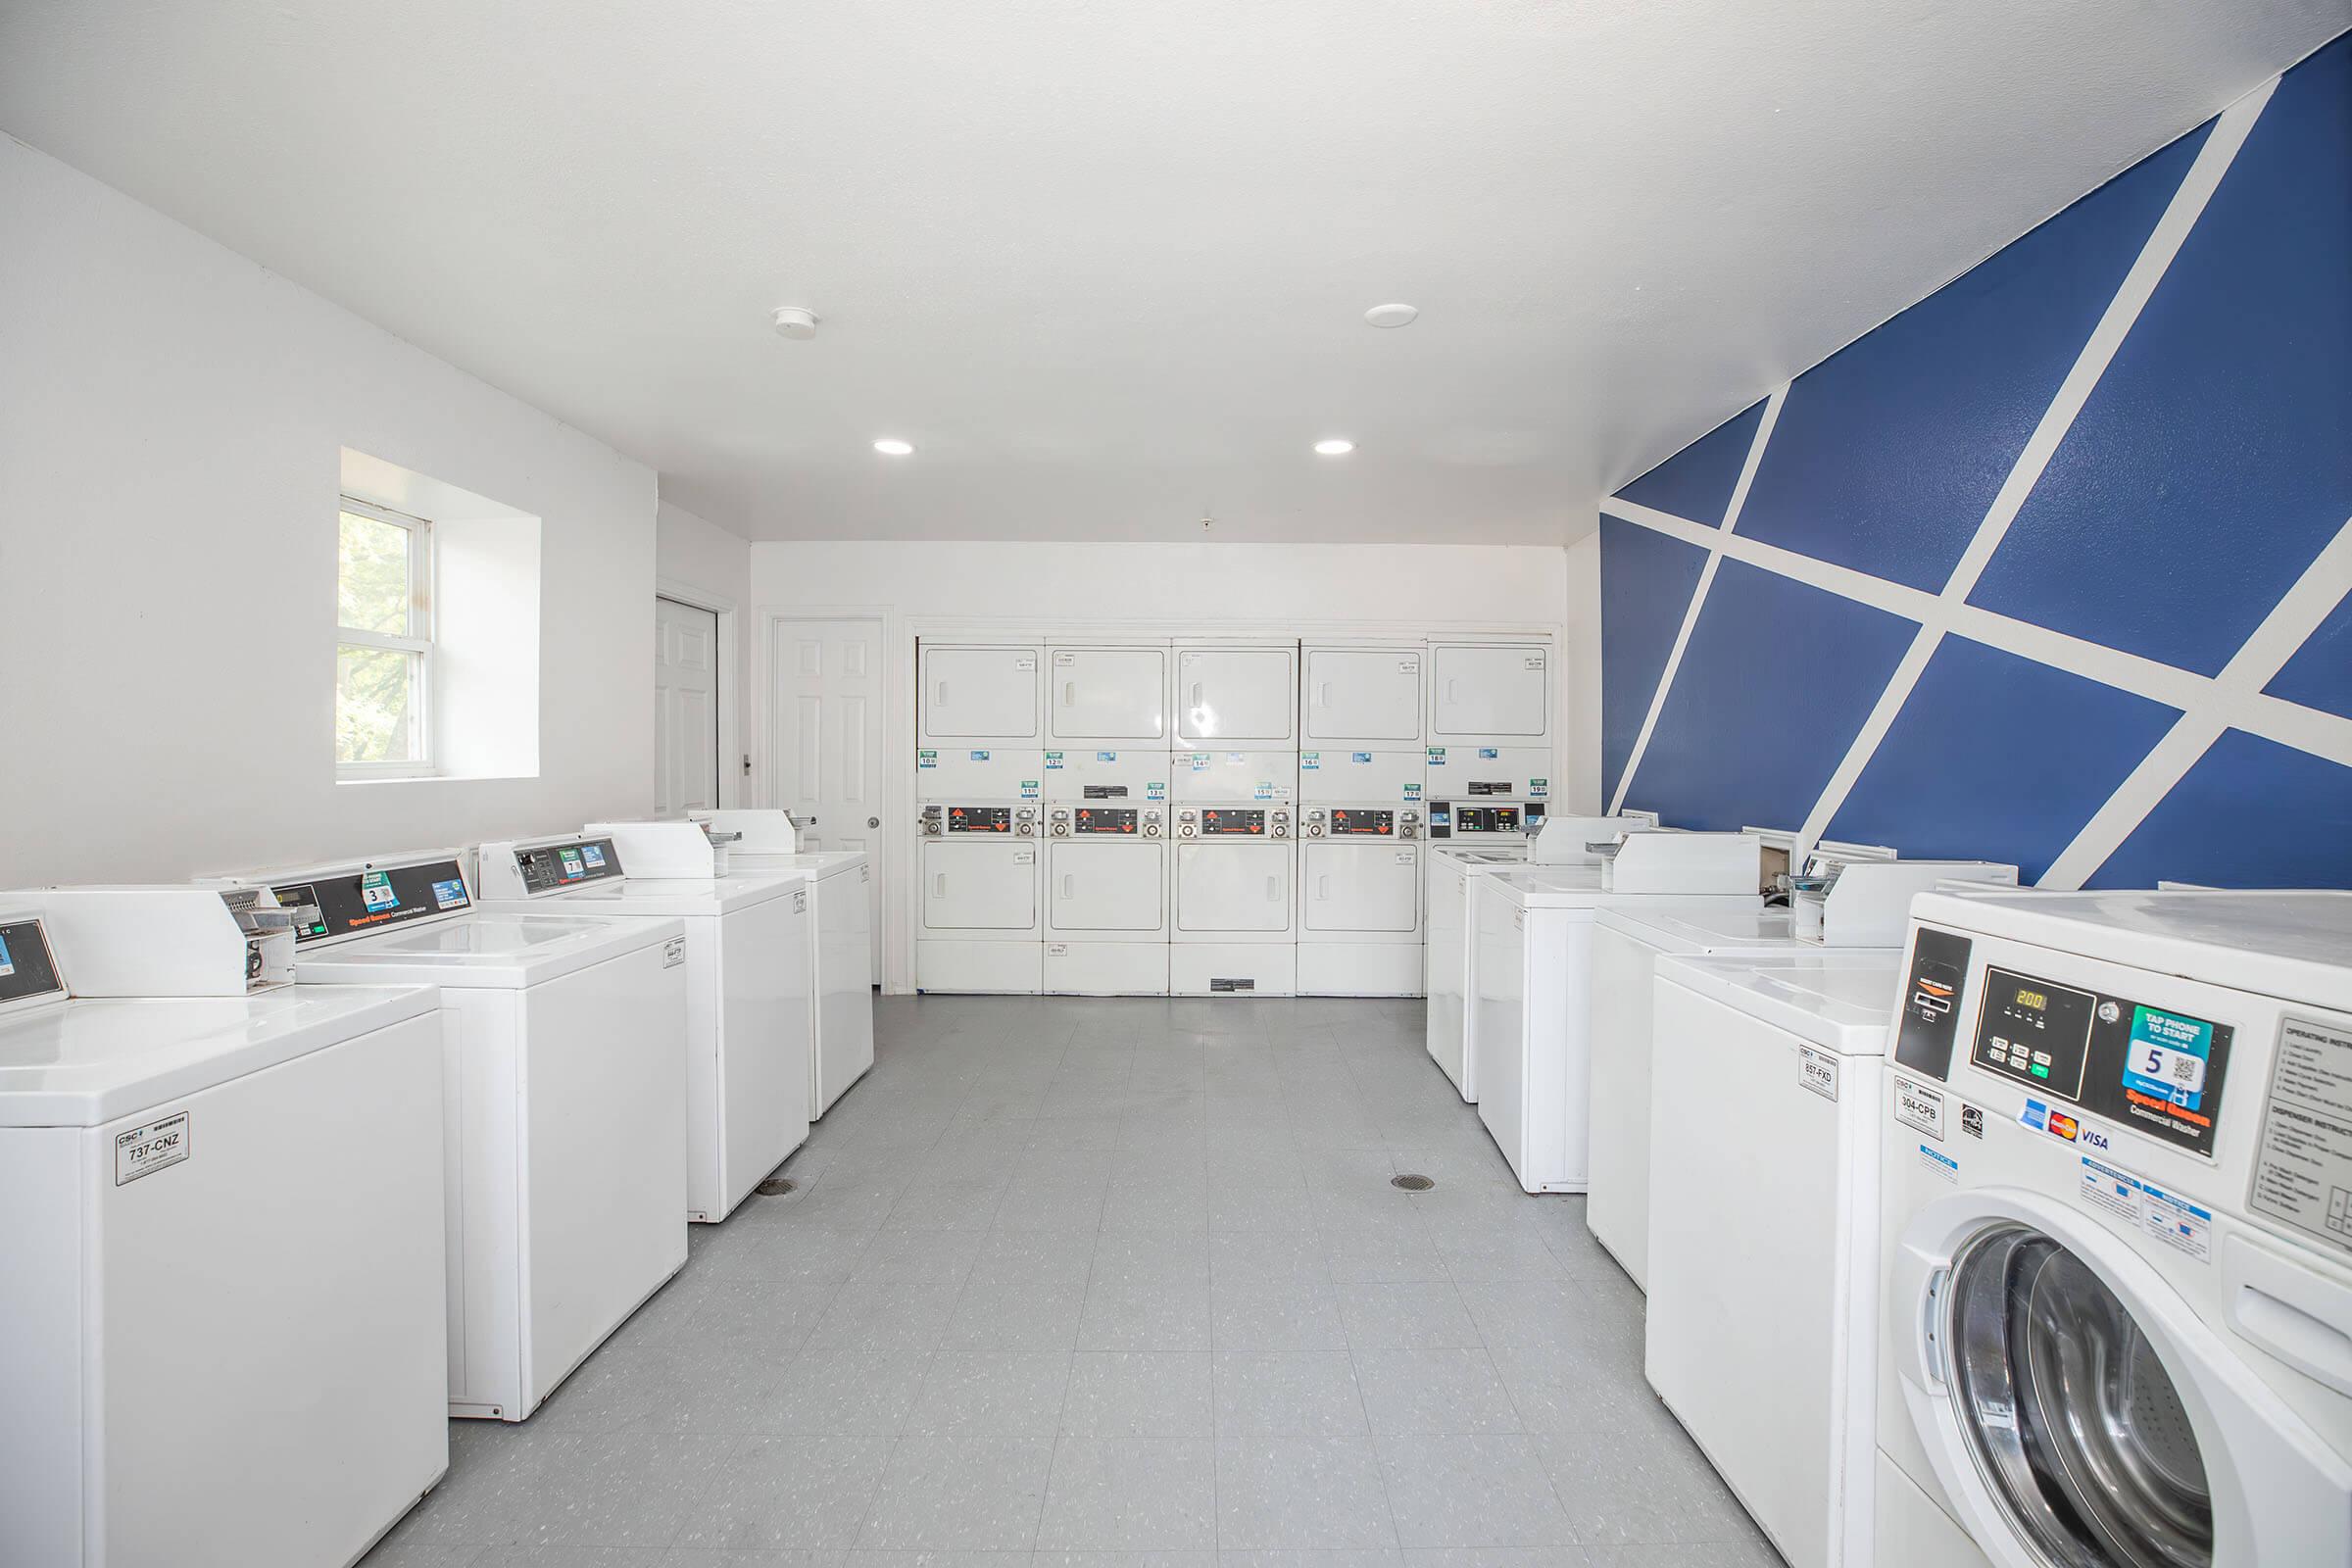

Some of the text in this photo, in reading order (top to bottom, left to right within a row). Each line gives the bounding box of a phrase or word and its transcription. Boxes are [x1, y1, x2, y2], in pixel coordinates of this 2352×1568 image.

[568, 862, 573, 871] 7
[368, 890, 377, 902] 3
[349, 915, 369, 927] Speed
[2017, 990, 2043, 1008] 200
[2145, 1013, 2201, 1036] TAP PHONE
[2147, 1022, 2196, 1043] TO START
[2285, 1027, 2328, 1044] OPERATING
[2145, 1049, 2163, 1074] 5
[1901, 1096, 1936, 1119] 304-CPB
[2126, 1088, 2167, 1111] Speed
[2130, 1104, 2201, 1138] Commercial Washer
[2272, 1105, 2314, 1125] DISPENSER
[119, 1132, 138, 1145] CSC
[128, 1133, 179, 1161] 737-CNZ
[2082, 1128, 2109, 1151] VISA
[1925, 1147, 1953, 1167] NOTICE
[2087, 1159, 2135, 1186] ADVERTENCIA
[2162, 1194, 2190, 1210] NOTICE
